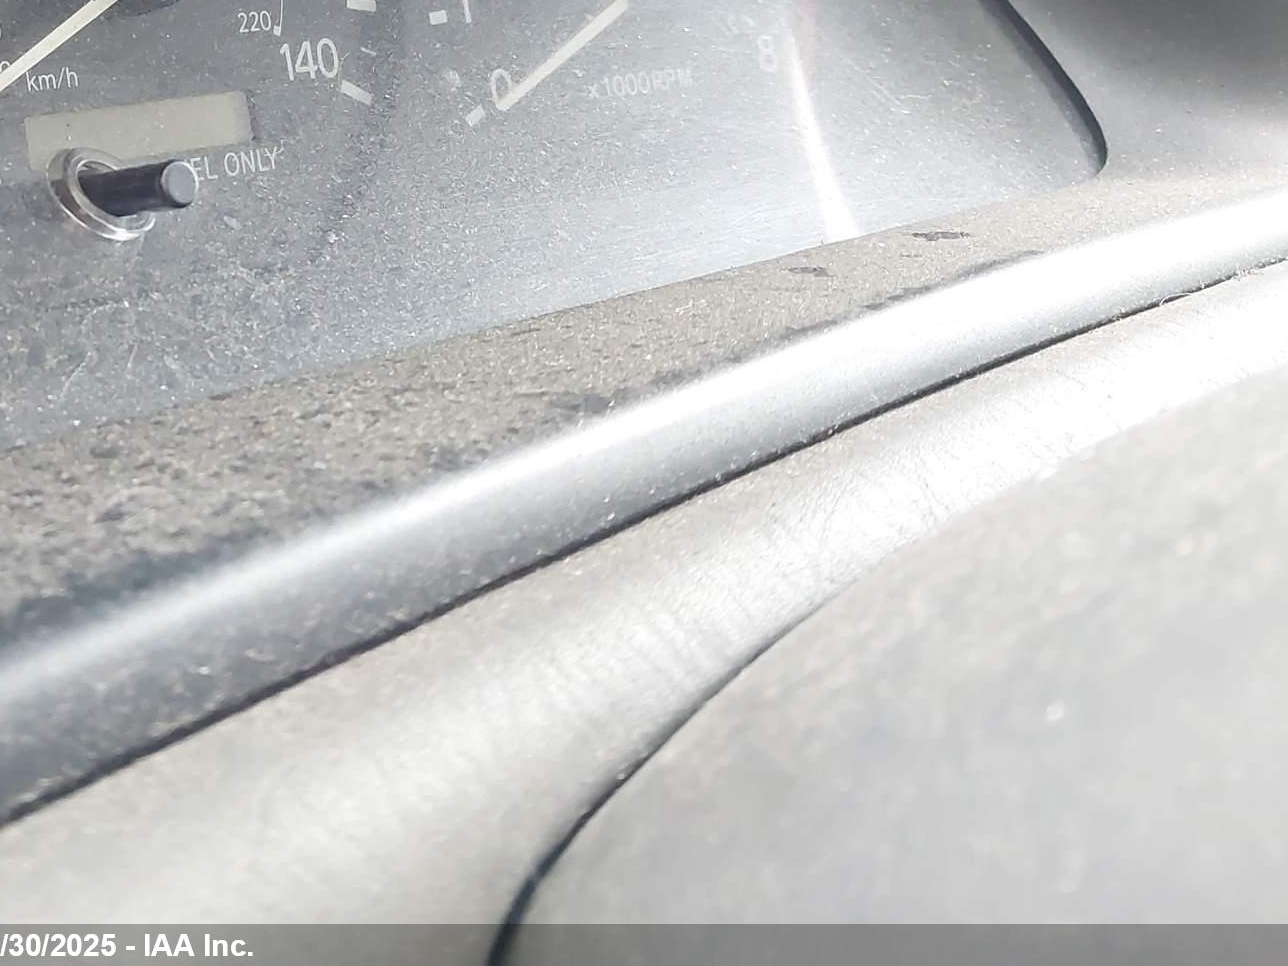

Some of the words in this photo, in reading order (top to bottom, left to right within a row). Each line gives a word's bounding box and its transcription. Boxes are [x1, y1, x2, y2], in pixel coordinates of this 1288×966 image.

[238, 12, 272, 34] 220
[279, 39, 339, 81] 140
[756, 34, 778, 72] 8
[25, 67, 79, 93] km/h
[490, 68, 513, 110] 0
[223, 145, 278, 176] ONLY
